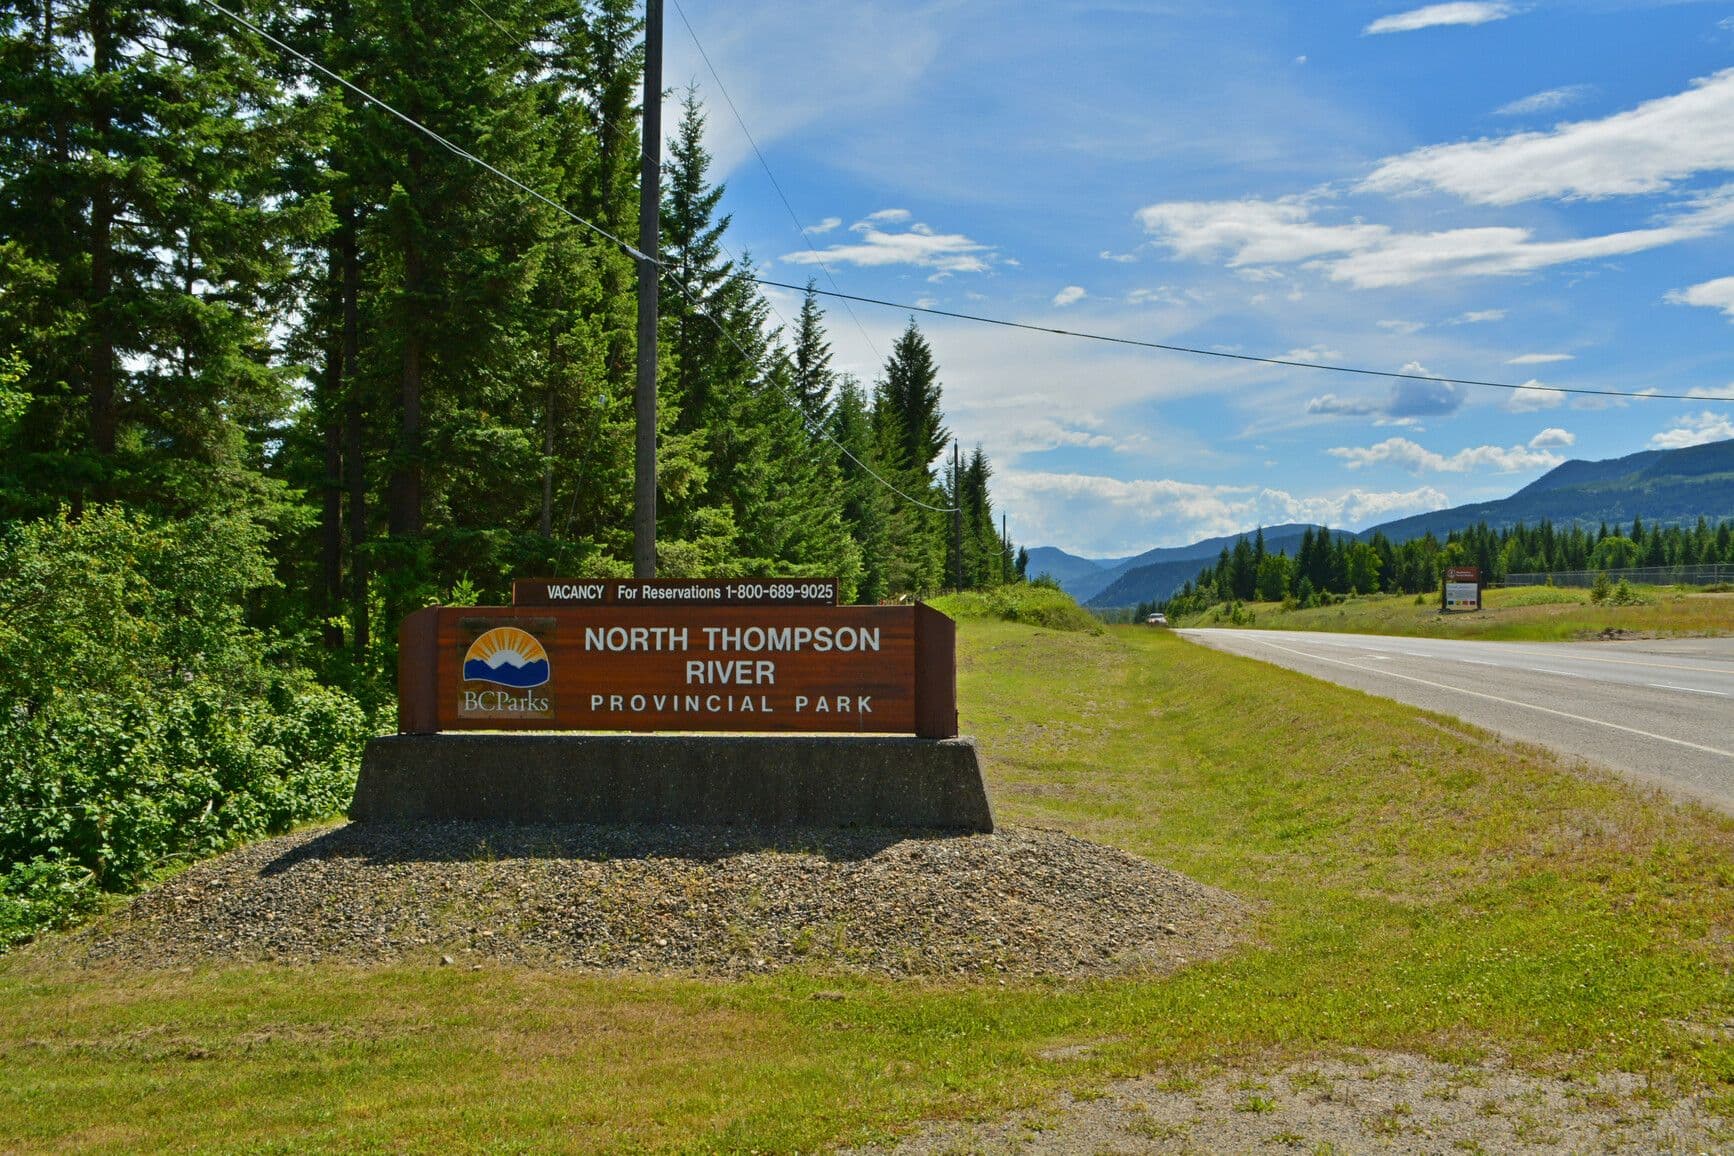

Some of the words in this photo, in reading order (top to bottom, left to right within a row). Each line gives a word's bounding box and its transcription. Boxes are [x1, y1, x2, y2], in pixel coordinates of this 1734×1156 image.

[547, 585, 605, 599] VACANCY
[617, 585, 638, 599] For
[642, 585, 721, 599] Reservations
[725, 584, 833, 599] 1-800-689-9025
[584, 626, 689, 652] NORTH
[702, 626, 881, 652] THOMPSON
[686, 660, 776, 685] RIVER
[591, 694, 774, 713] PROVINCIAL
[795, 695, 873, 713] PARK
